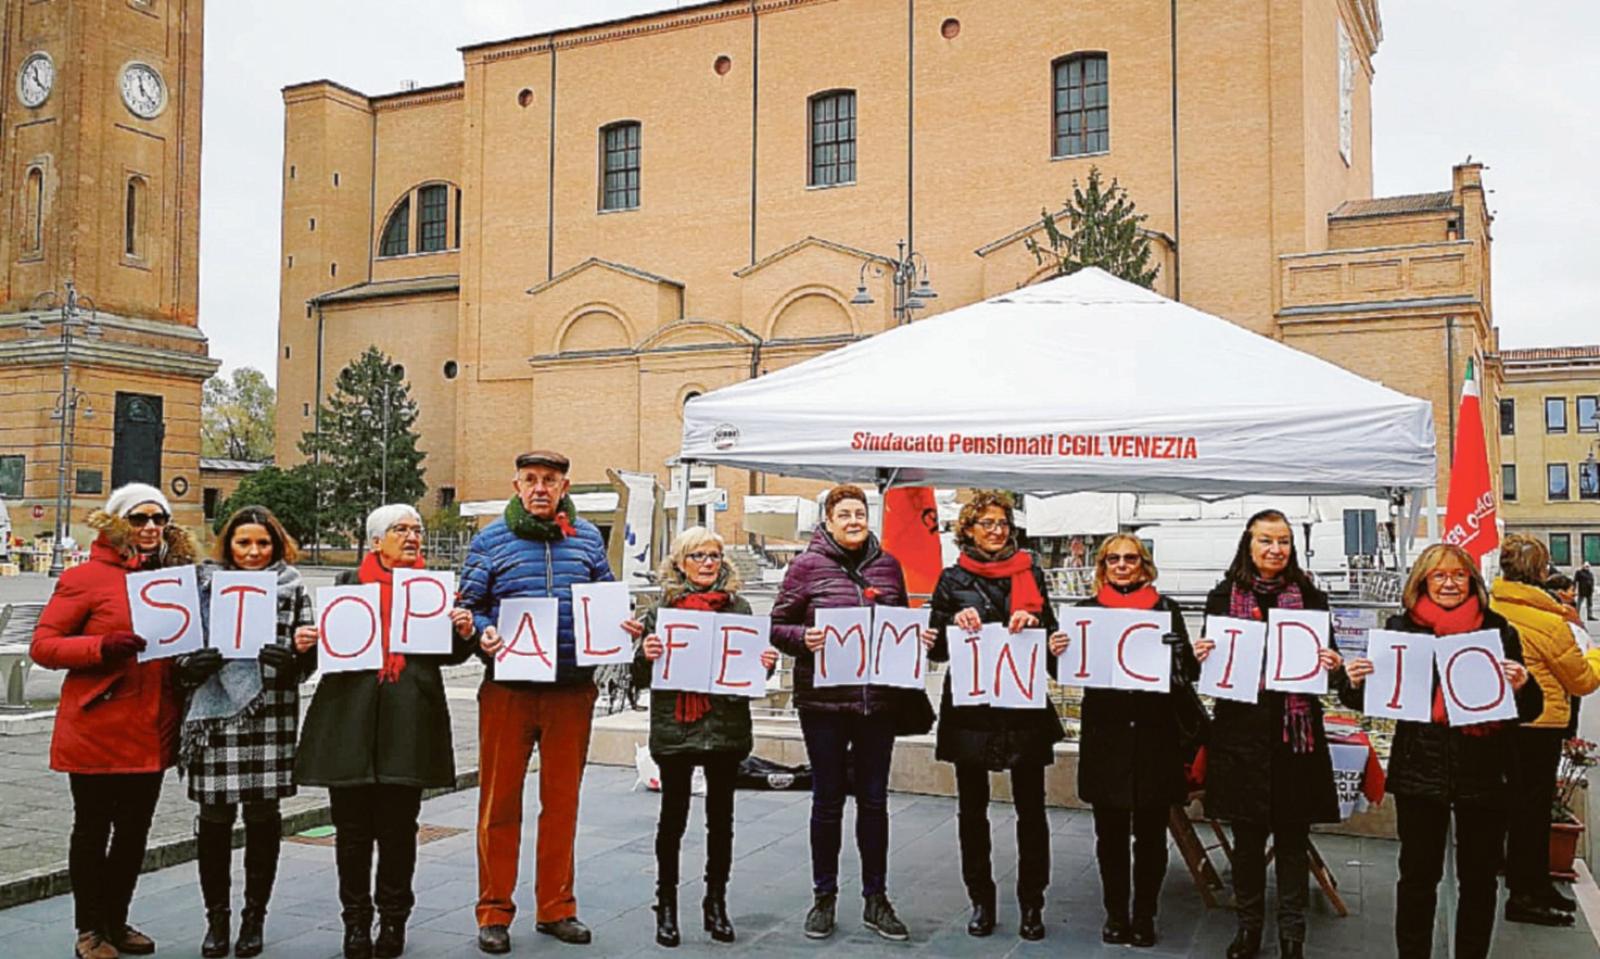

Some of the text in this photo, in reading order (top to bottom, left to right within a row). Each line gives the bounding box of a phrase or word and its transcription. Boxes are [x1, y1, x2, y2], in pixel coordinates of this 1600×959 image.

[851, 431, 1197, 460] Sindacato Pensionati CGIL VENEZIA
